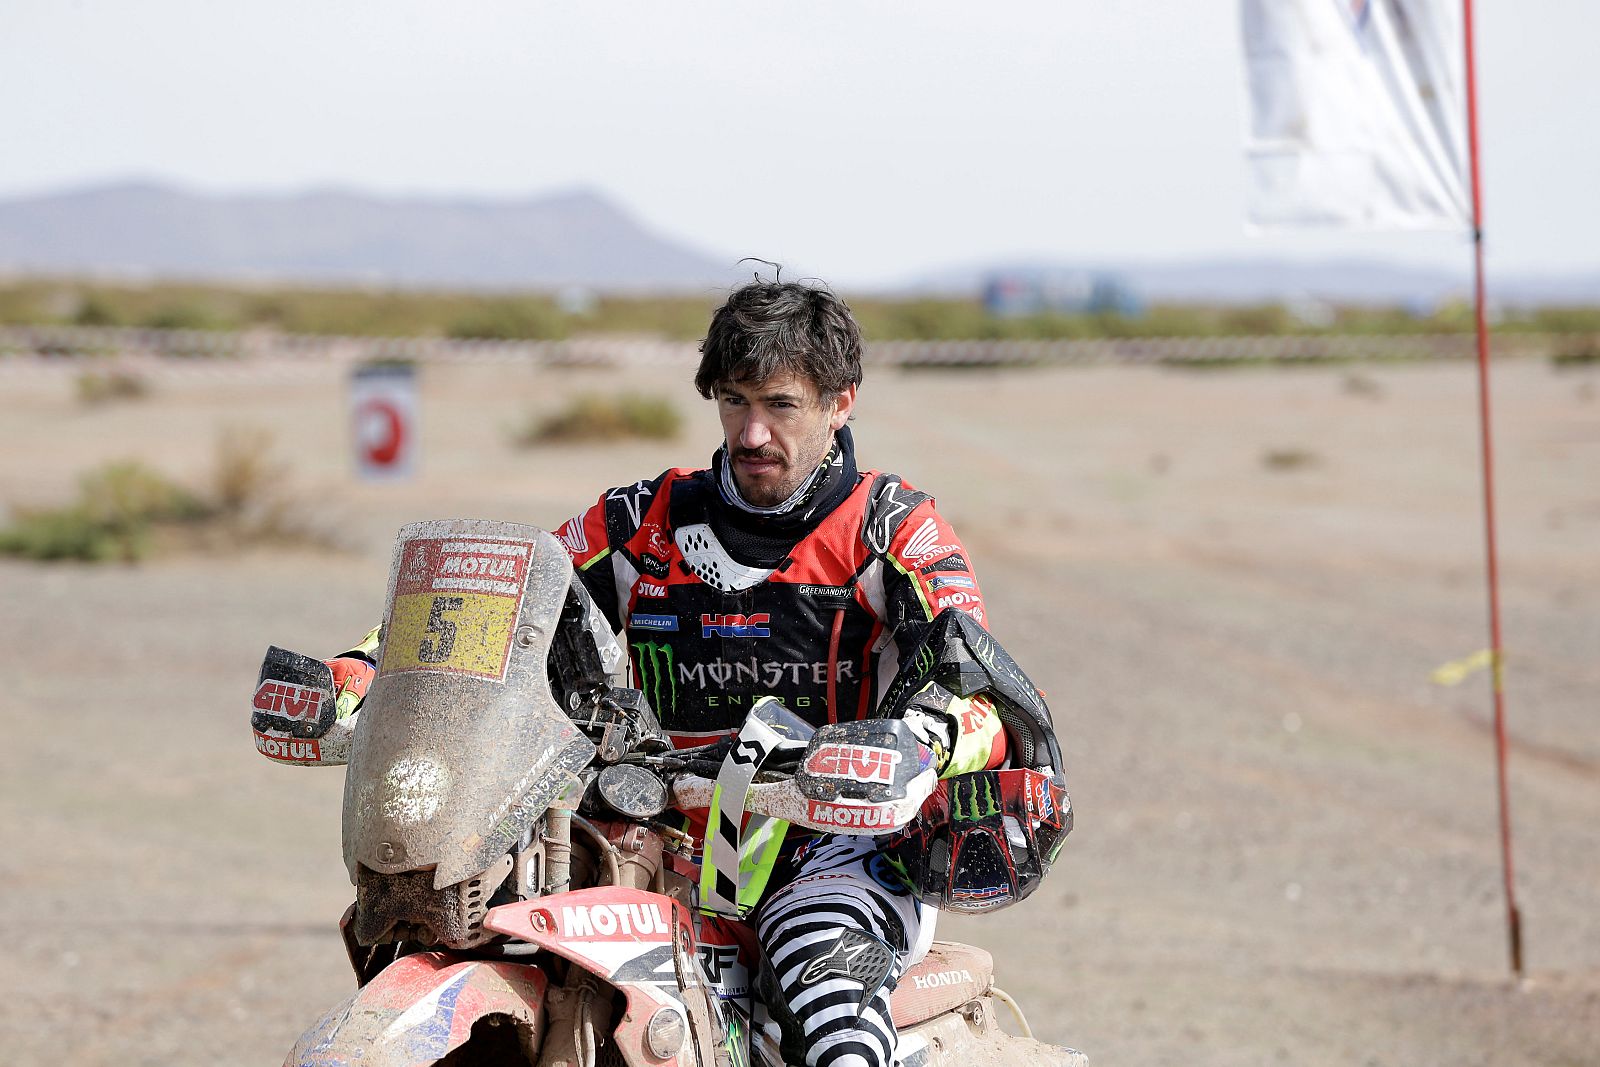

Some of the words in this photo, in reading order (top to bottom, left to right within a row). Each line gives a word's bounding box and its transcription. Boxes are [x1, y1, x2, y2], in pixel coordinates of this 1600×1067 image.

[440, 556, 517, 578] MOTUL
[911, 544, 961, 569] HONDA
[418, 596, 464, 663] 5
[634, 619, 672, 627] MICHELIN
[702, 613, 771, 638] HRC
[677, 656, 858, 689] MONSTER
[253, 682, 321, 719] GIVI
[255, 734, 316, 759] MOTUL
[805, 747, 893, 780] GIVI
[812, 804, 894, 826] MOTUL
[562, 903, 669, 938] MOTUL
[911, 969, 974, 990] HONDA
